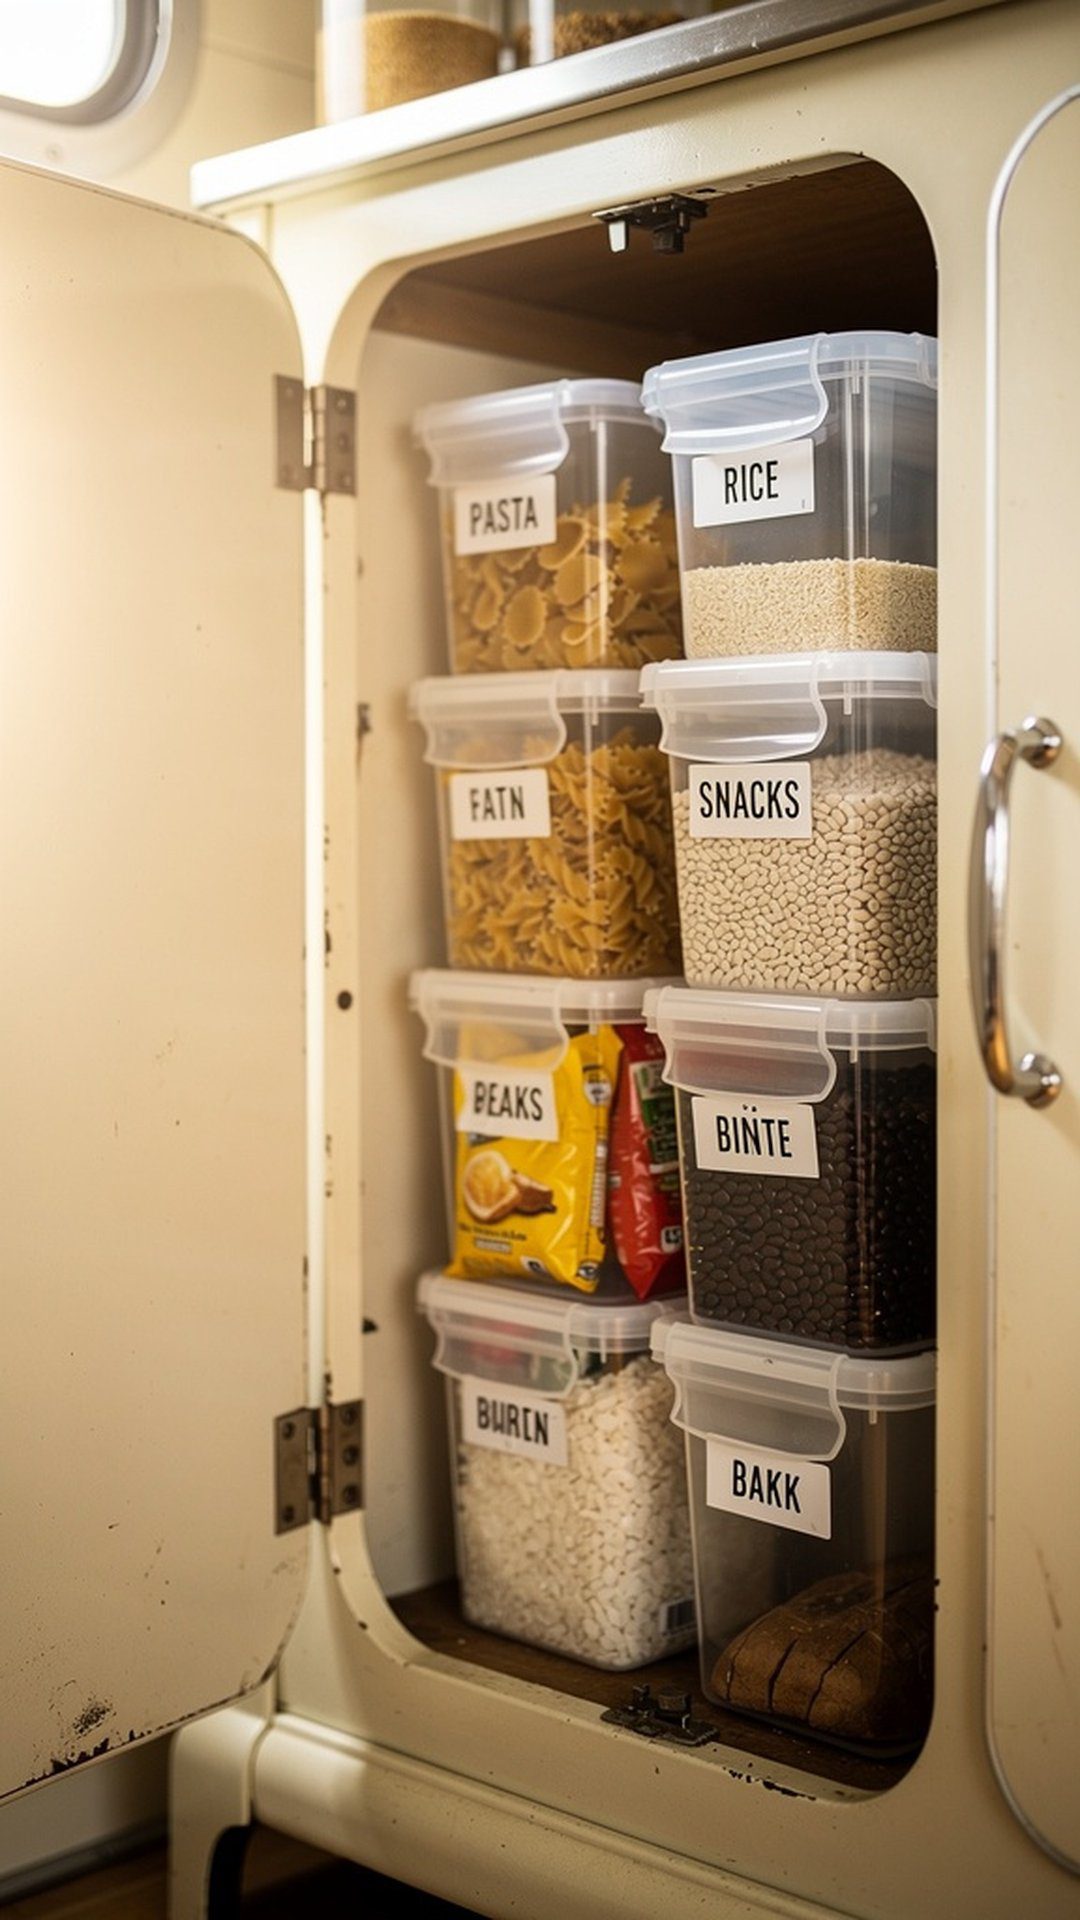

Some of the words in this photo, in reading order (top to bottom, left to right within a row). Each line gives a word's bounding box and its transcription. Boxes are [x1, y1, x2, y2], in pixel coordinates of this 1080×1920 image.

[724, 460, 778, 504] RICE
[470, 496, 538, 537] PASTA
[700, 780, 800, 818] SNACKS
[473, 1081, 544, 1121] BEAKS
[732, 1460, 801, 1513] BAKK
